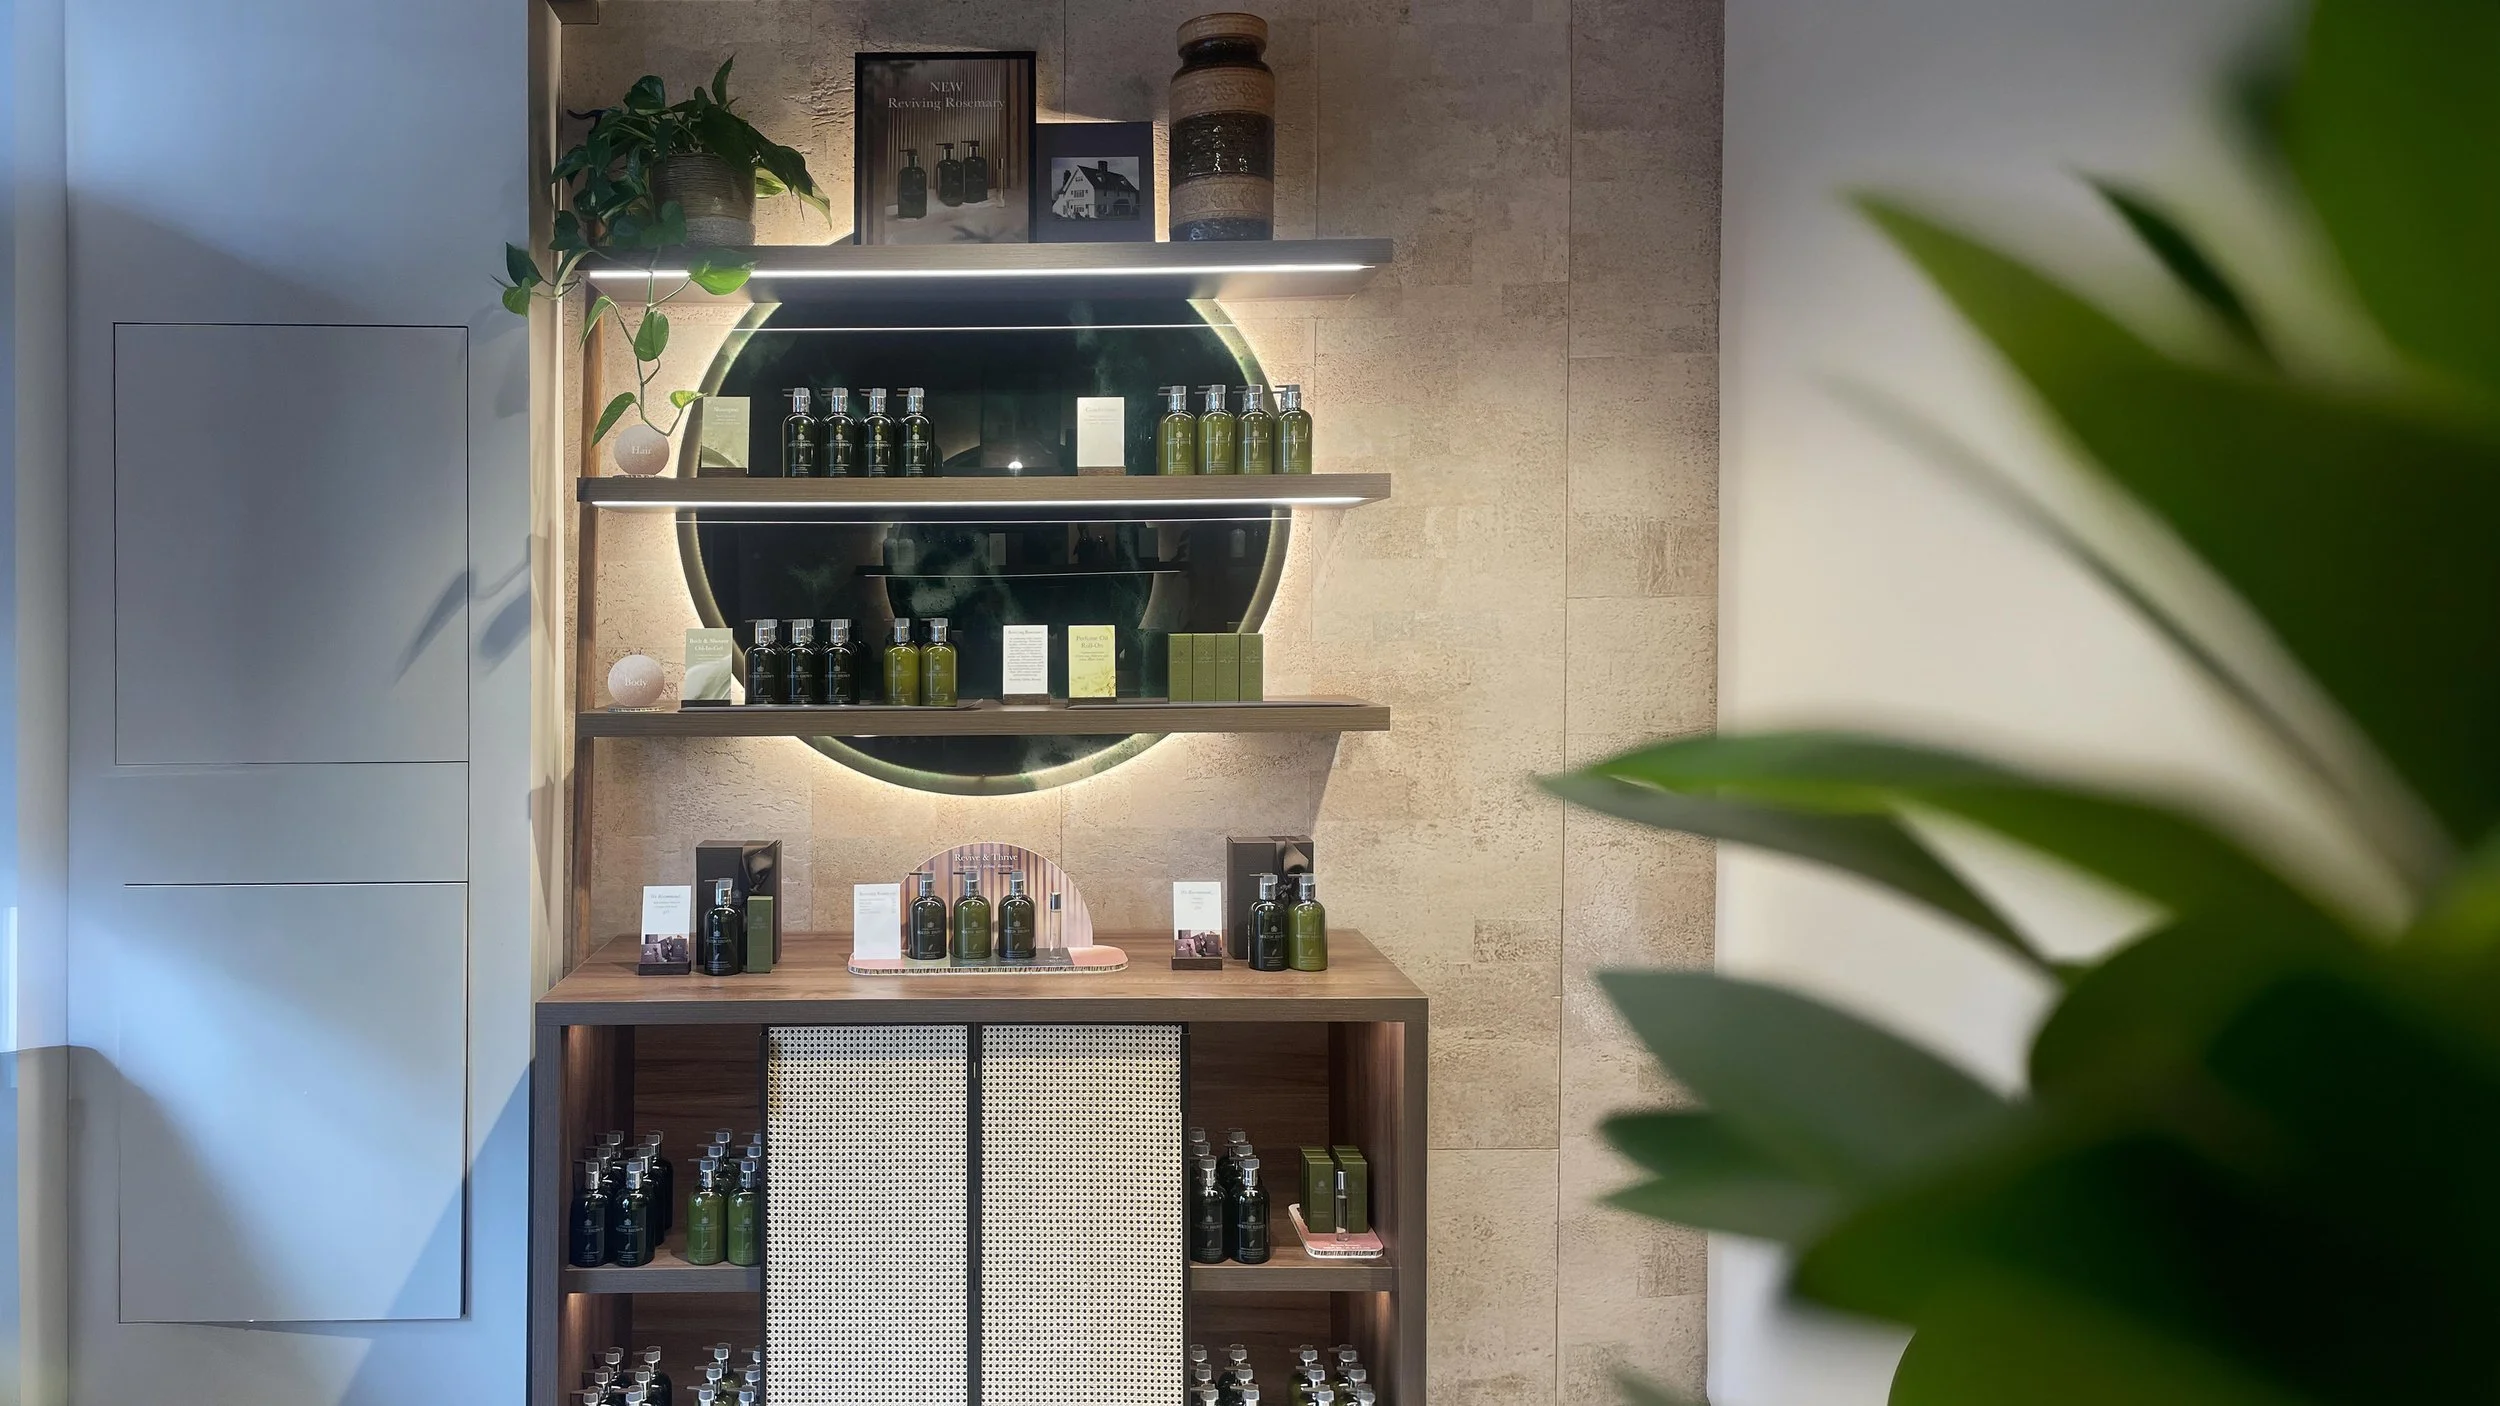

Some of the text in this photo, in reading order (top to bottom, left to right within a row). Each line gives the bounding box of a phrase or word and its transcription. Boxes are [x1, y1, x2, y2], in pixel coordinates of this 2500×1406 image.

[929, 81, 964, 92] NEW
[888, 97, 1006, 111] Reviving Rosemary
[631, 445, 652, 455] Hair
[625, 678, 648, 689] Body
[954, 853, 981, 861] Revive
[991, 853, 1018, 861] Thrive
